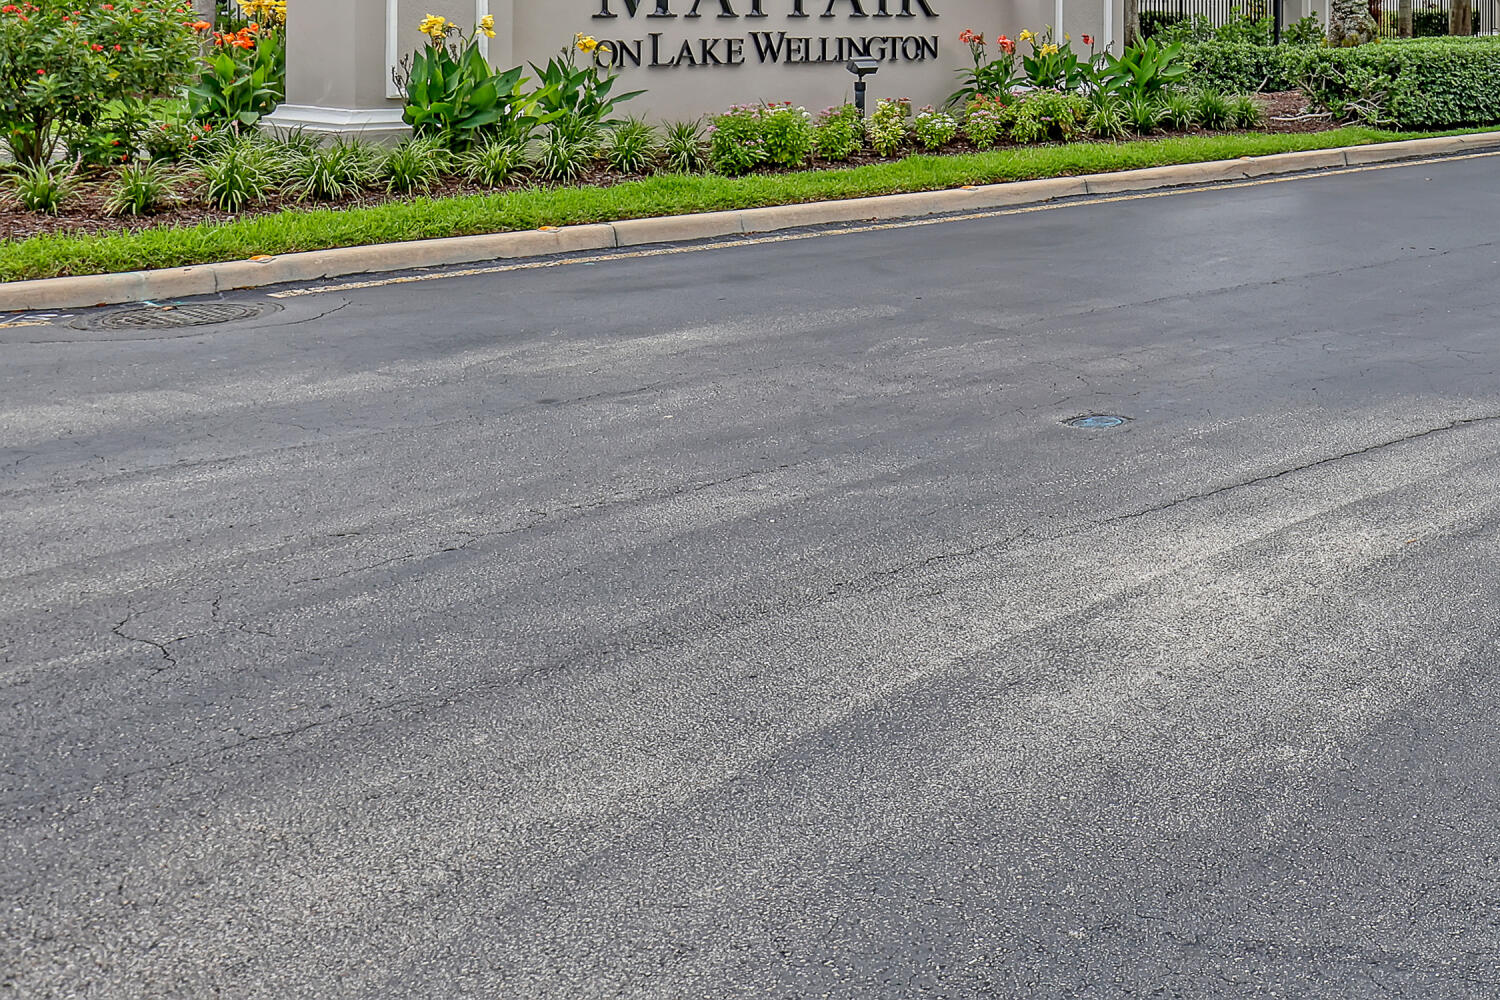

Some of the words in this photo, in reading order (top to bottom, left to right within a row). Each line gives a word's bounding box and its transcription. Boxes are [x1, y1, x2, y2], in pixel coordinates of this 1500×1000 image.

[593, 39, 642, 68] ON
[648, 32, 746, 68] LAKE
[748, 31, 940, 65] WELLINGTON
